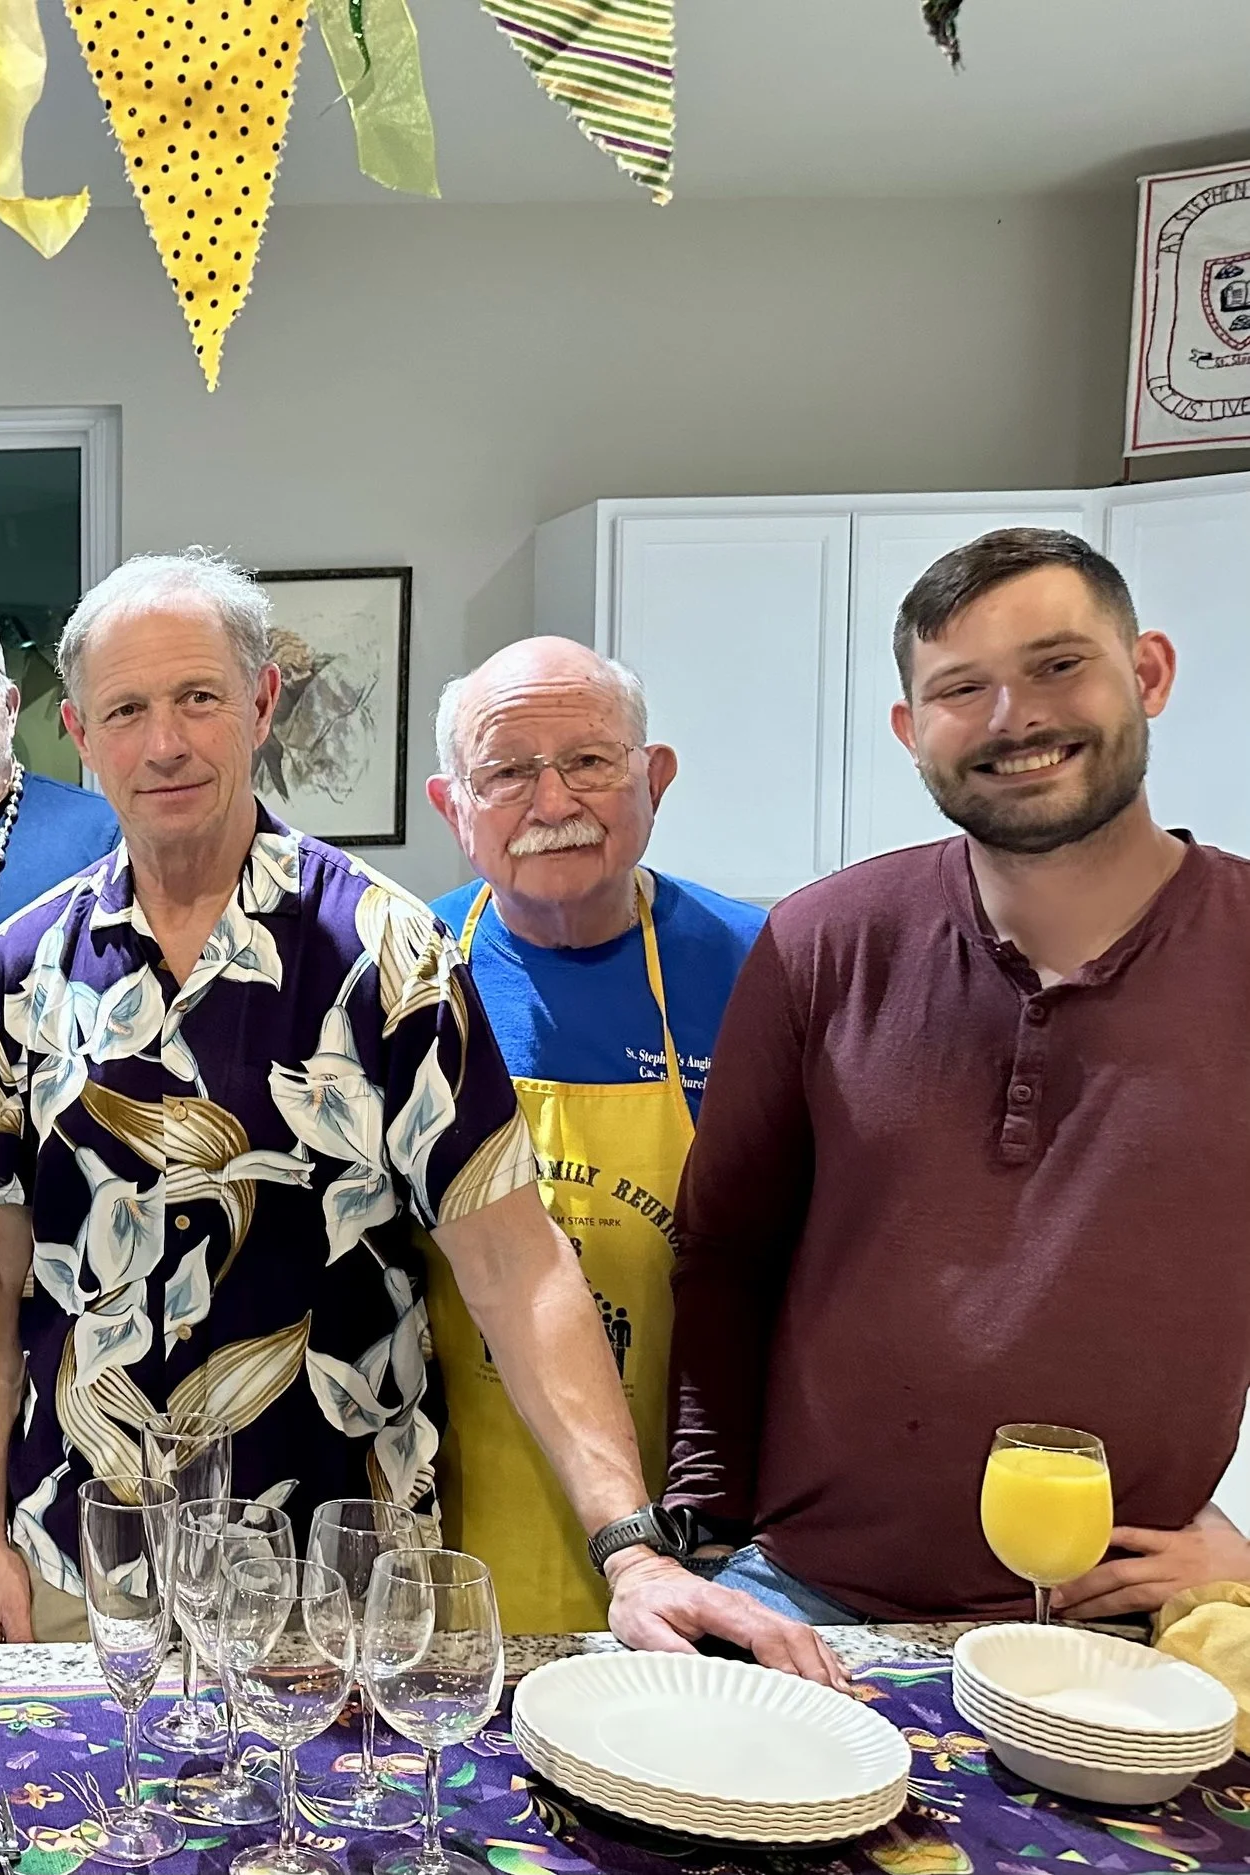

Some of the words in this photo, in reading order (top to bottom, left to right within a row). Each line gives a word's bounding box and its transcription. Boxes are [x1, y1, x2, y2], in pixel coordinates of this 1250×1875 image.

[1158, 232, 1183, 254] AS
[639, 1049, 685, 1067] Steph's
[680, 1074, 707, 1090] hurc
[538, 1160, 602, 1188] MILY
[610, 1177, 681, 1259] REUNIO
[568, 1217, 595, 1227] STATE
[598, 1218, 622, 1227] PARK
